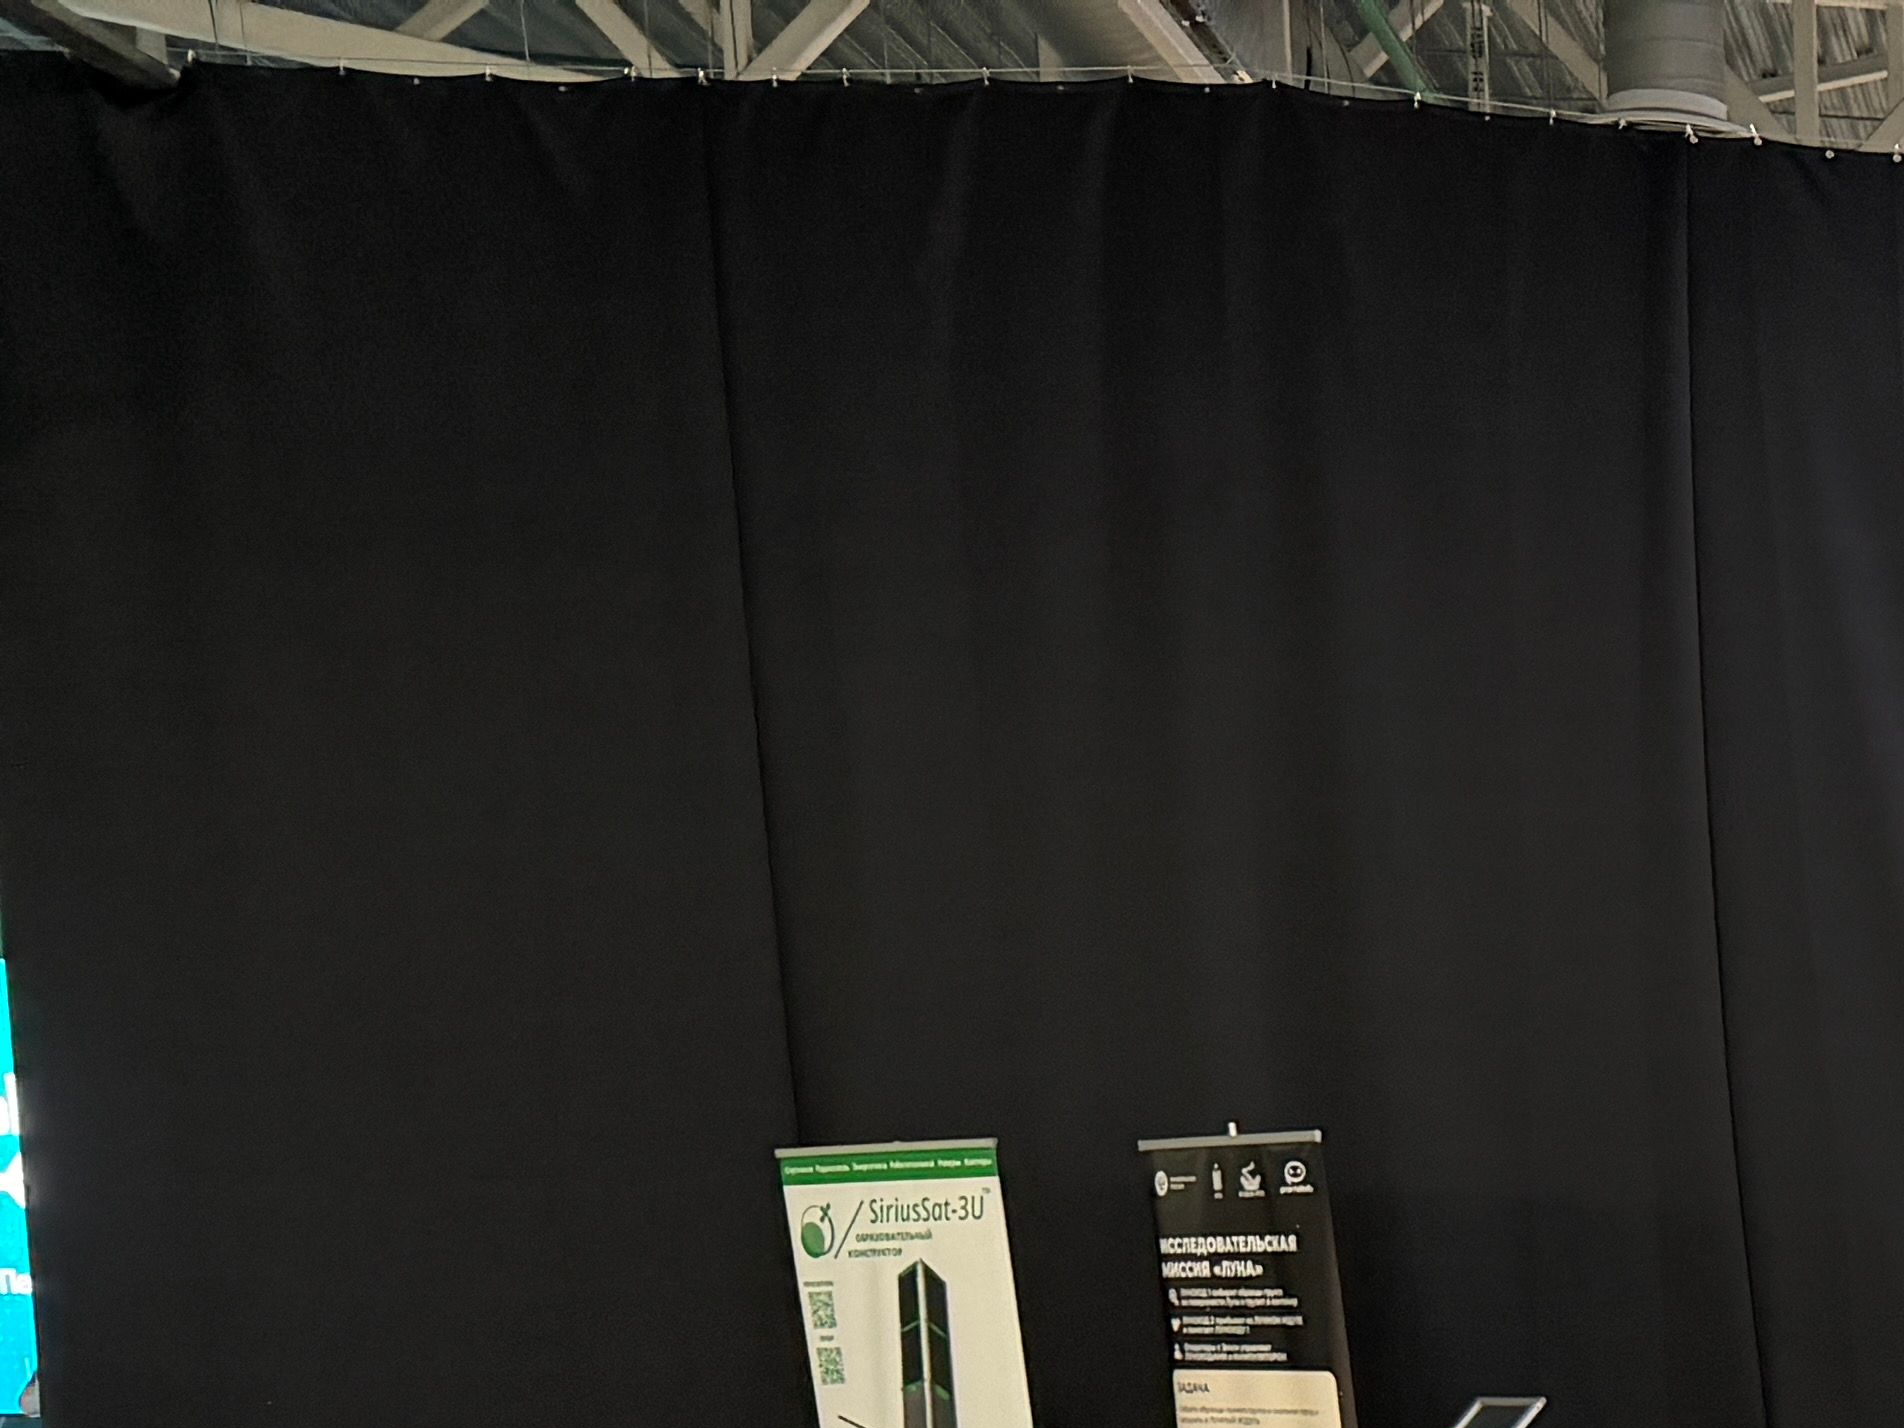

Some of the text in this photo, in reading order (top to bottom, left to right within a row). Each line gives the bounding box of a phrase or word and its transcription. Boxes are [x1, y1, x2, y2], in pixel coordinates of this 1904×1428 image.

[869, 1195, 984, 1224] SiriusSat-3U
[1159, 1234, 1298, 1255] ИССЛЕДОВАТЕЛЬСКАЯ
[1161, 1259, 1264, 1278] МИССИЯ «ЛУНА»
